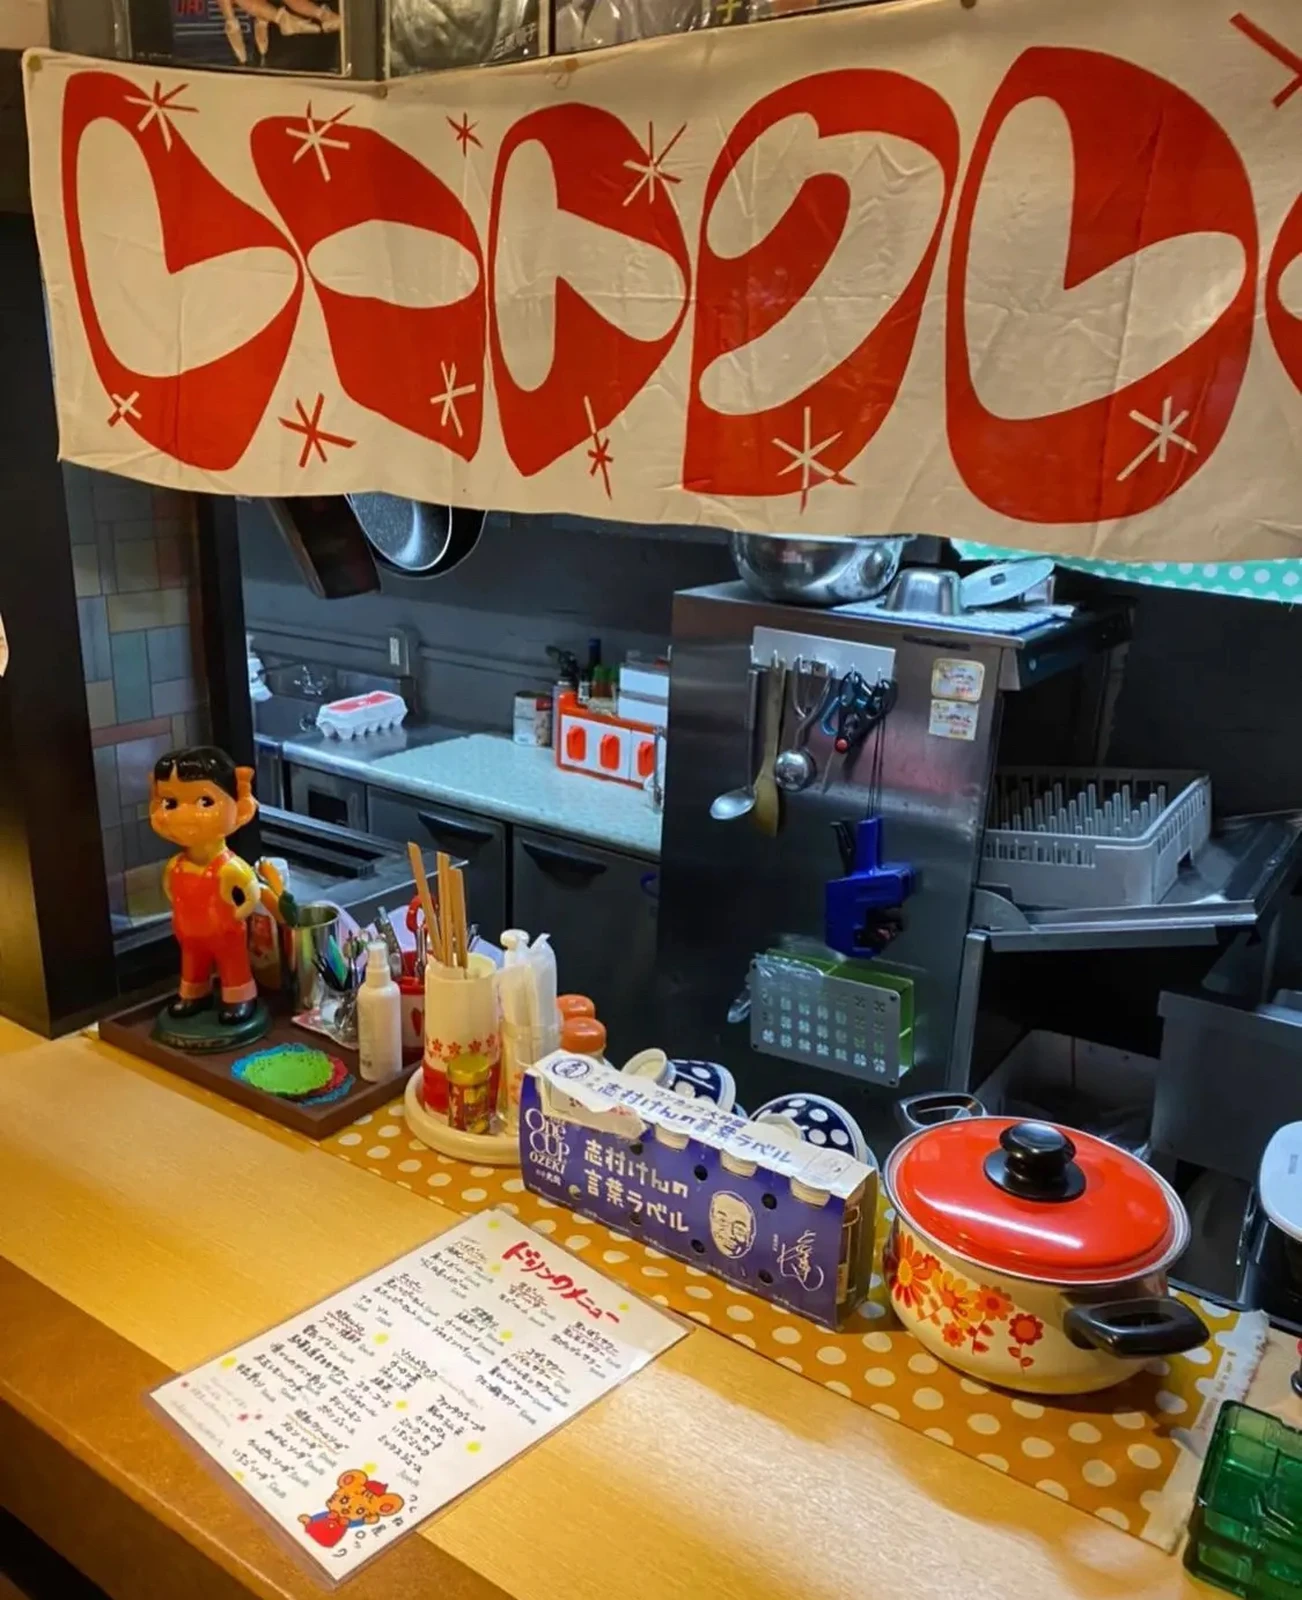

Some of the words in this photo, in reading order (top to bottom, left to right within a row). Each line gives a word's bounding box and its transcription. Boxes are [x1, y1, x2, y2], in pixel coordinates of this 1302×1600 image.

[76, 96, 1302, 421] レートクレ
[525, 1108, 567, 1140] One
[583, 1138, 689, 1199] 志村けんの
[584, 1168, 690, 1233] 言葉ラベル
[501, 1240, 619, 1323] ドリンクメニュー
